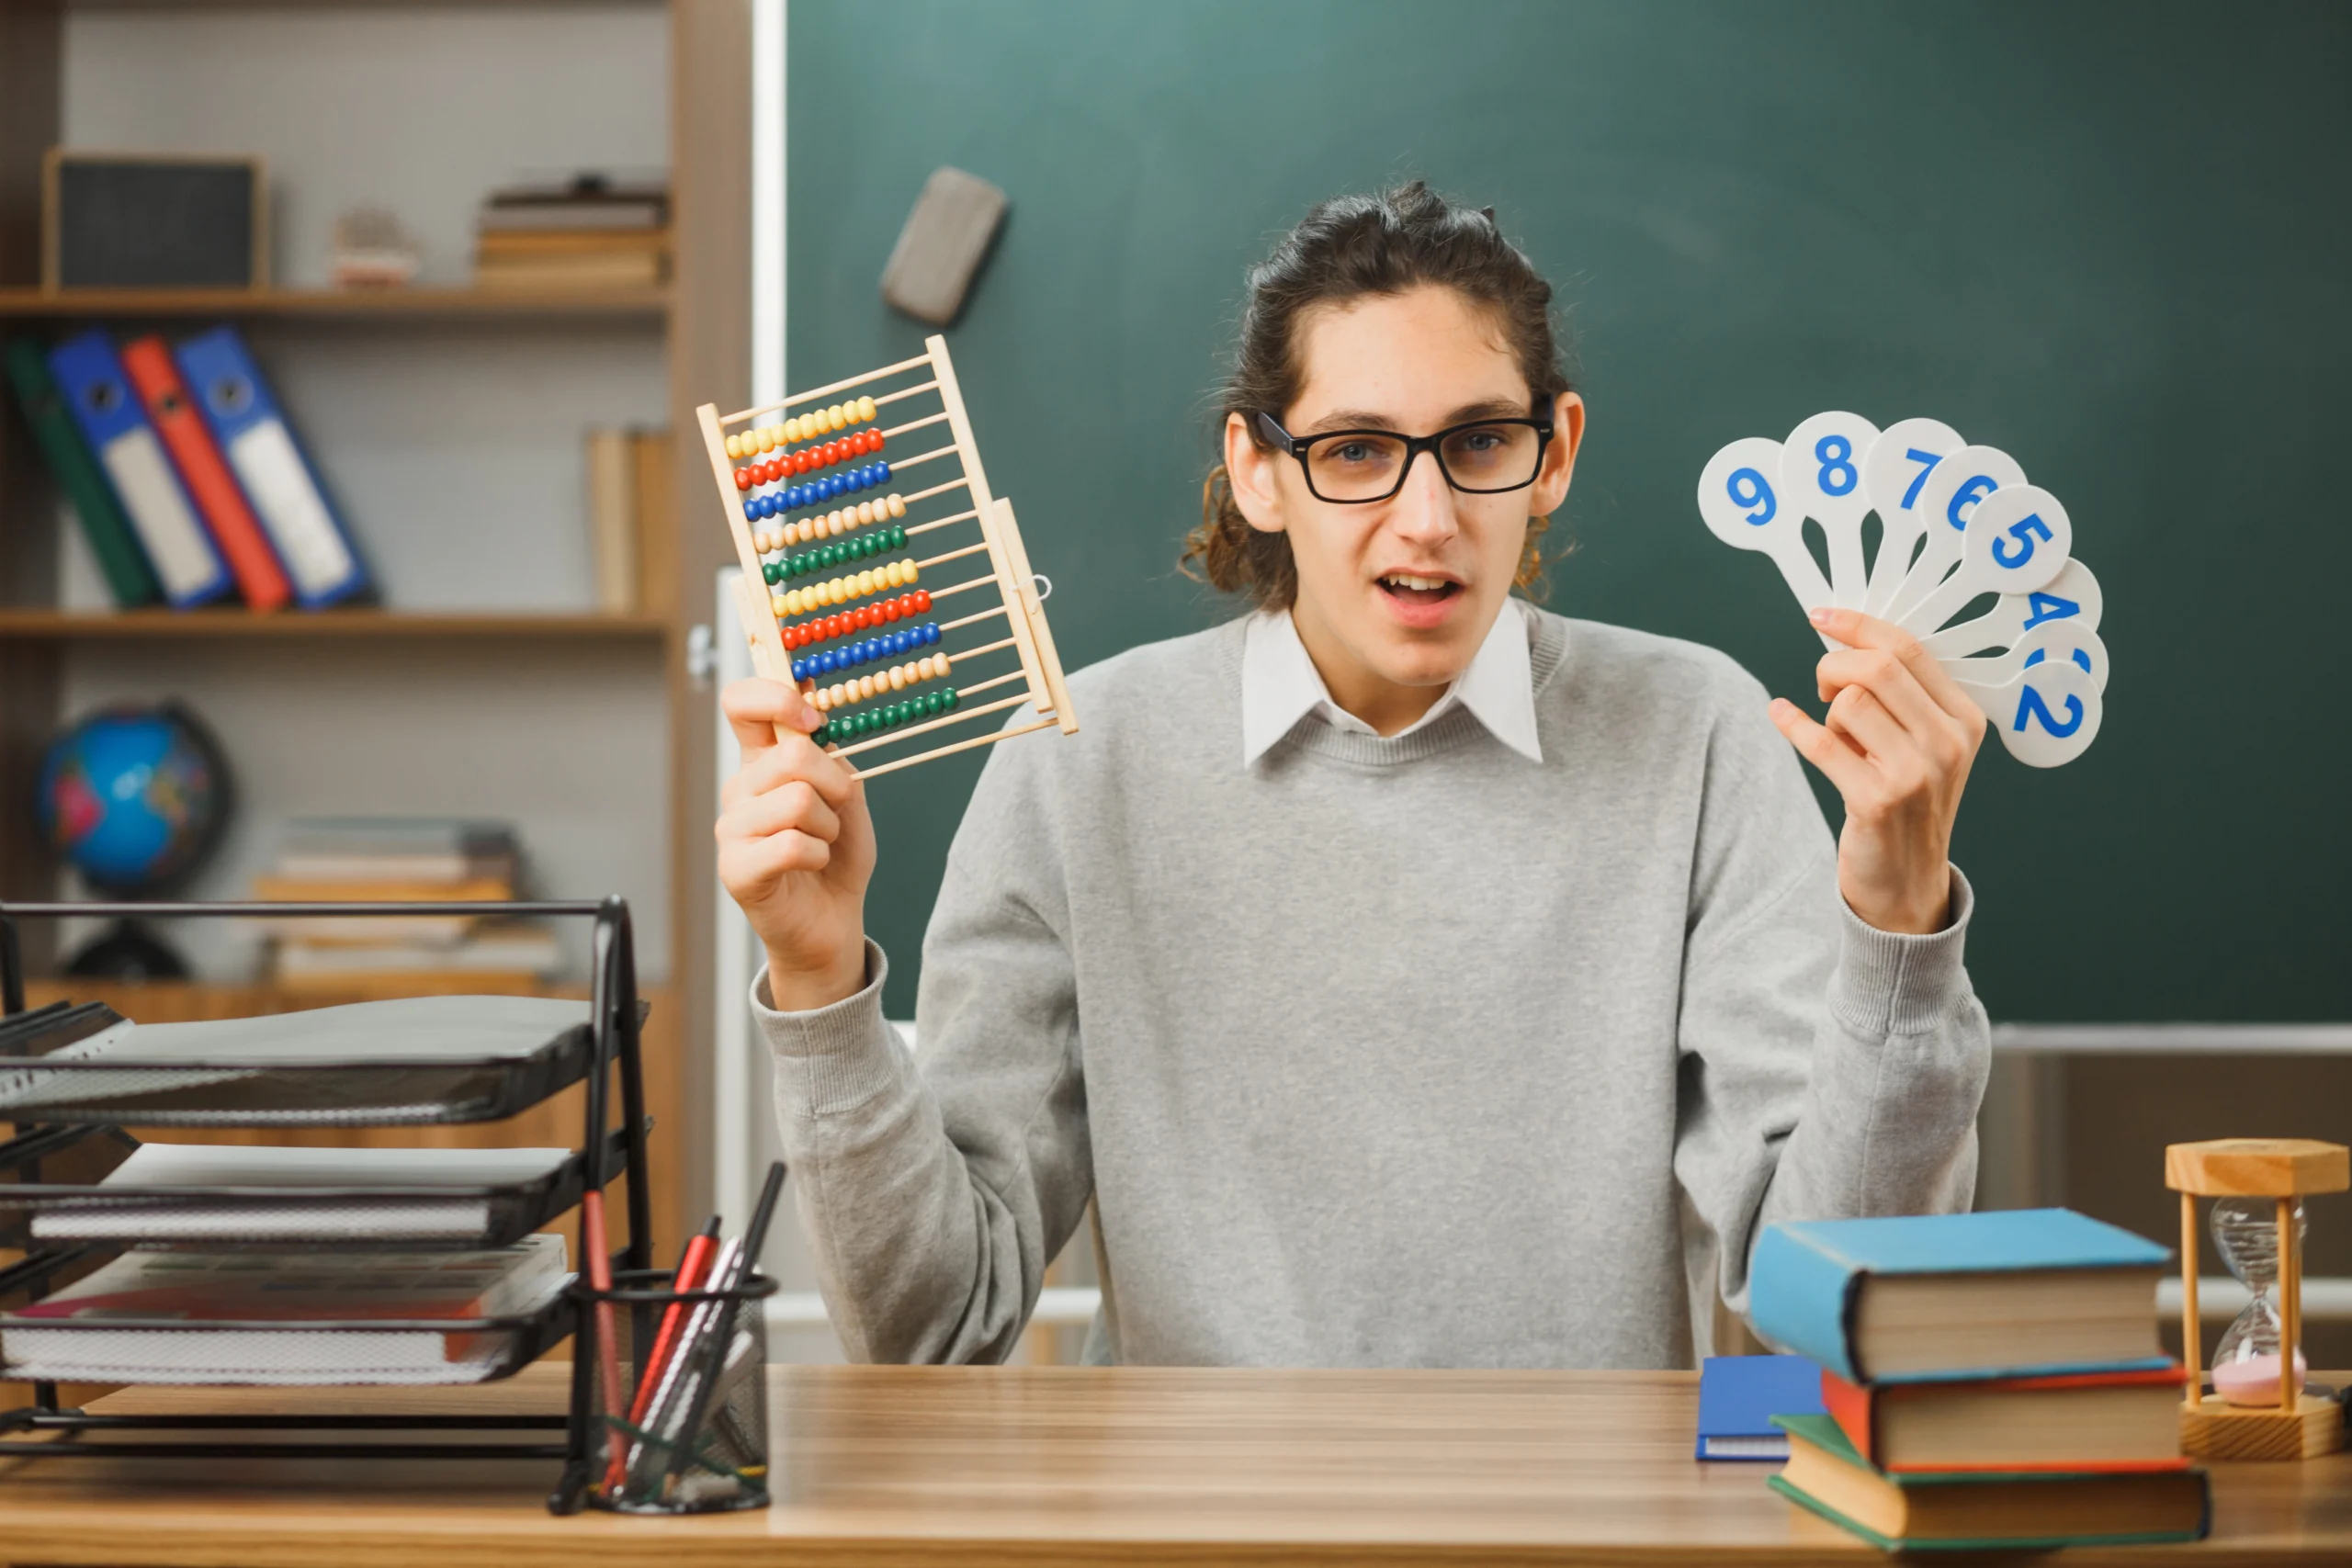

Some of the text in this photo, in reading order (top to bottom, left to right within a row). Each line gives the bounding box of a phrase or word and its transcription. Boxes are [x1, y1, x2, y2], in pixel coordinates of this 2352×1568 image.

[1815, 434, 1859, 497] 8
[1900, 447, 1943, 511] 7
[1726, 467, 1777, 526] 9
[1947, 475, 1998, 532] 6
[1991, 513, 2053, 570] 5
[2023, 592, 2081, 631] 4
[2013, 684, 2084, 739] 2
